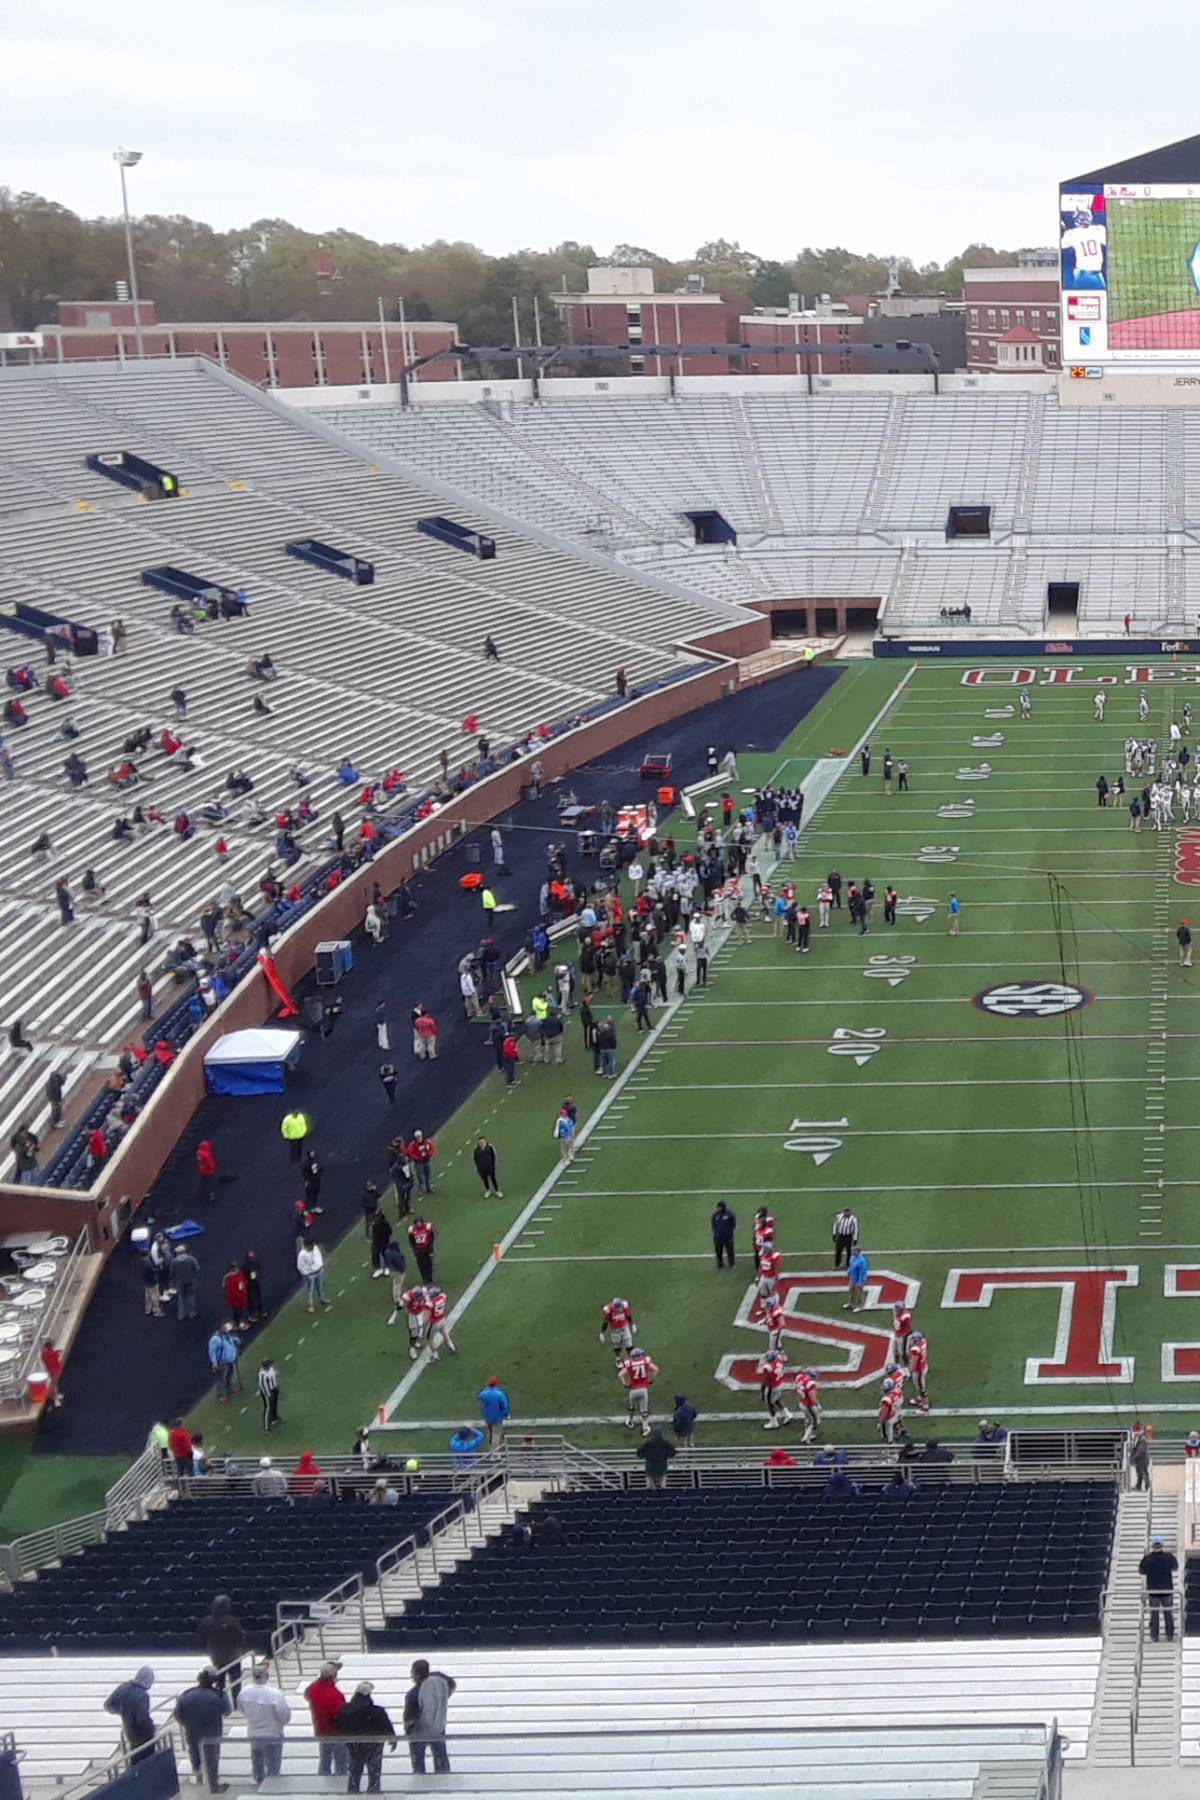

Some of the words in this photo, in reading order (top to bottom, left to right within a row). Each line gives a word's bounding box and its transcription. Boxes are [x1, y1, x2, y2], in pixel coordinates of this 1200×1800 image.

[1071, 367, 1085, 378] 25
[862, 955, 917, 978] 30
[827, 1027, 886, 1055] 20
[783, 1117, 849, 1151] 10
[632, 1364, 646, 1379] 71
